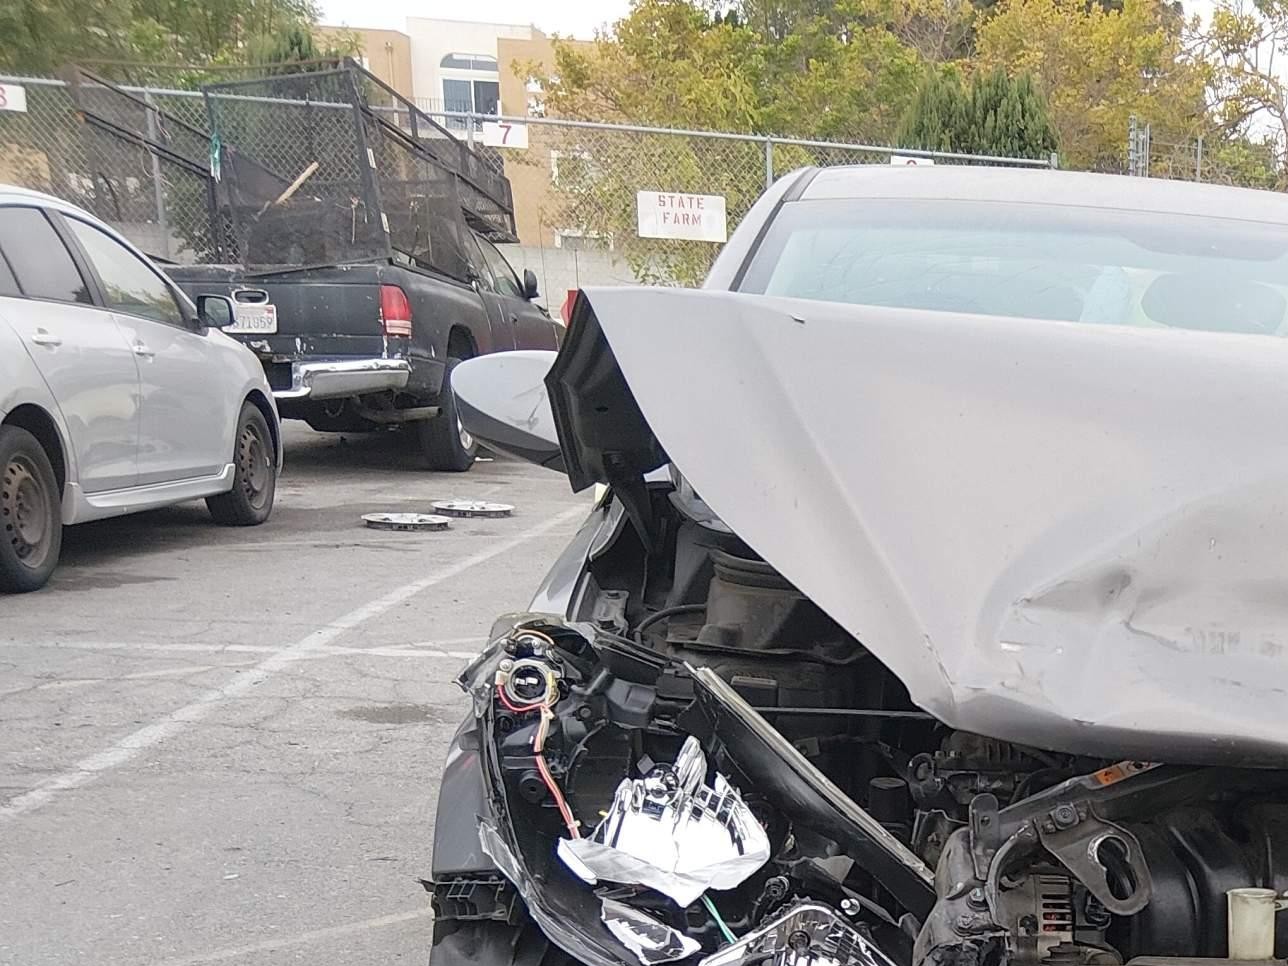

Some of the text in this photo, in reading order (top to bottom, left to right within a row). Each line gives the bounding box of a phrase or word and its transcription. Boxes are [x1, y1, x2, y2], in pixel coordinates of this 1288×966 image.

[499, 124, 512, 145] 7
[658, 194, 704, 210] STATE
[663, 211, 702, 226] FARM
